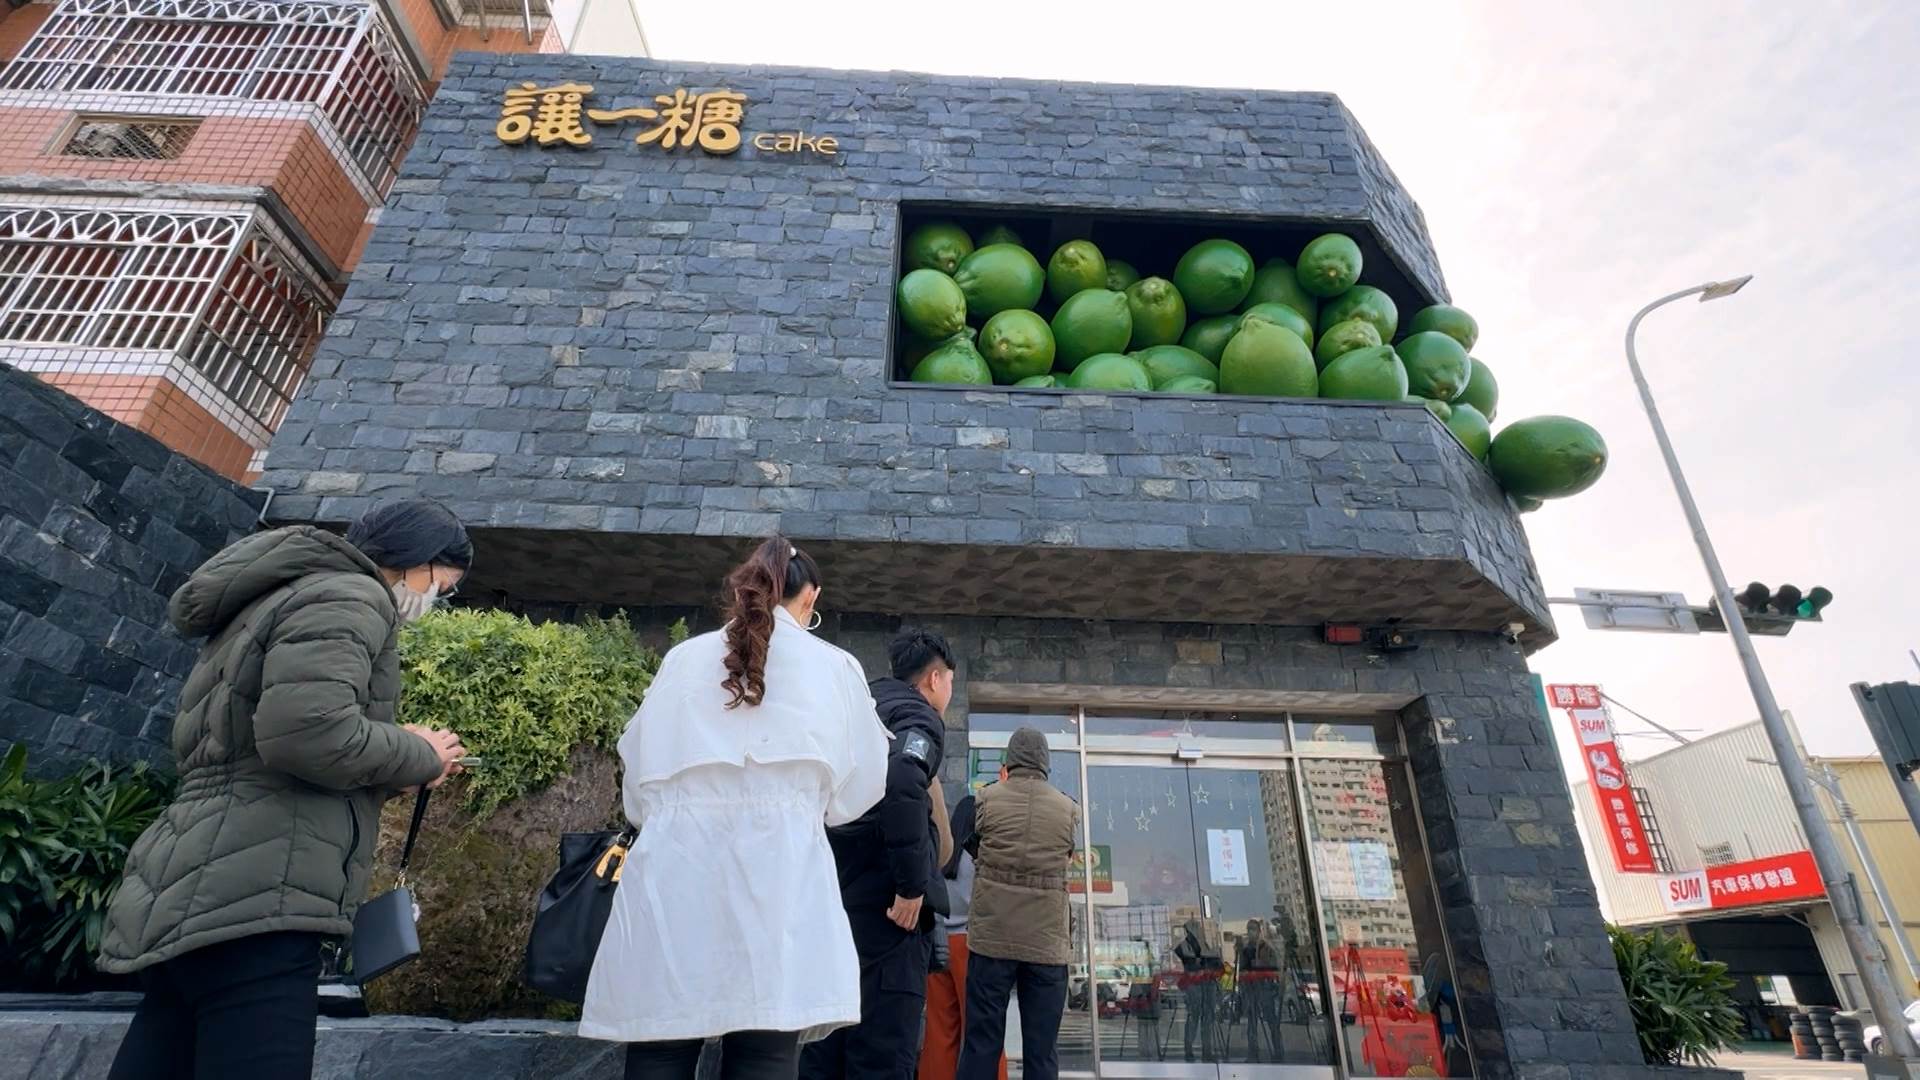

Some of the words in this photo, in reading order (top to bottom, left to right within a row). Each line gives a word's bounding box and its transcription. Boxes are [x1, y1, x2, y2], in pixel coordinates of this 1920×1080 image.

[496, 81, 747, 154] 讓一糖
[753, 131, 840, 155] cake
[1580, 719, 1606, 733] SUM
[1669, 877, 1703, 901] SUM
[1711, 866, 1798, 896] 汽車保修聯盟
